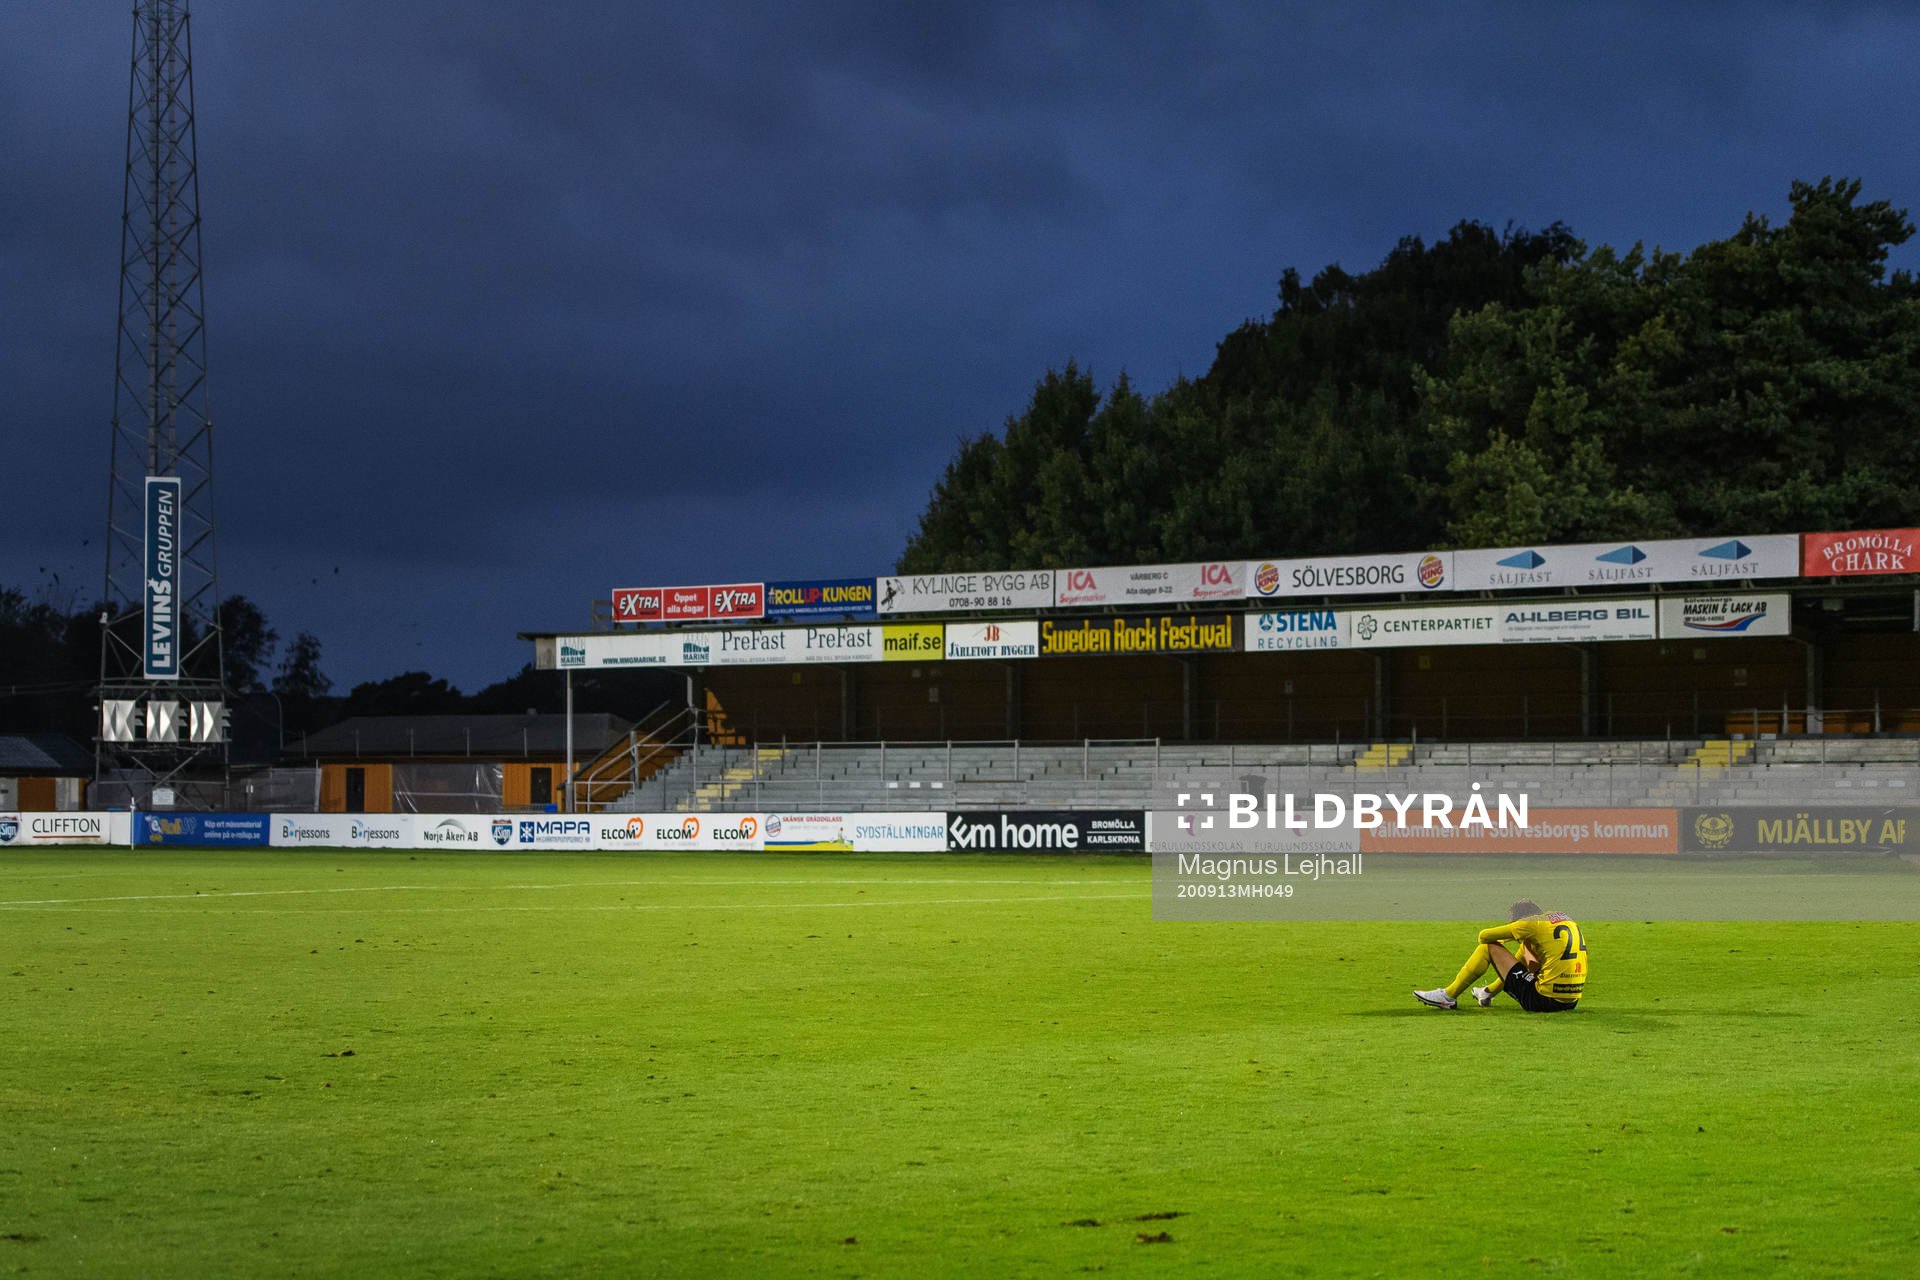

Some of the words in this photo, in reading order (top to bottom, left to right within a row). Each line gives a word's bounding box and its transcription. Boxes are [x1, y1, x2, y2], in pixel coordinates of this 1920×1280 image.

[157, 489, 173, 577] GRUPPEN
[1823, 533, 1913, 560] BROMÖLLA
[1831, 553, 1905, 572] CHARK
[1067, 570, 1097, 591] ICA
[1201, 564, 1233, 585] ICA
[1258, 573, 1280, 588] KING
[1292, 565, 1405, 587] SÖLVESBORG
[1421, 567, 1444, 583] KING
[912, 575, 977, 595] KYLINGE
[984, 574, 1025, 593] BYGG
[1029, 573, 1050, 590] AB
[674, 592, 698, 603] Öppet
[949, 598, 985, 608] 0708-90
[987, 597, 998, 606] 88
[1002, 596, 1012, 606] 16
[667, 604, 682, 613] alla
[683, 603, 705, 615] dagar
[1505, 609, 1609, 623] AHLBERG
[1616, 608, 1650, 620] BIL
[1683, 603, 1719, 615] MASKIN
[1731, 601, 1754, 613] LACK
[1754, 601, 1767, 613] AB
[151, 579, 172, 668] LEVINS
[1276, 609, 1337, 633] STENA
[1383, 617, 1494, 633] CENTERPARTIET
[805, 626, 873, 649] PreFast
[984, 624, 999, 641] JB
[1042, 619, 1111, 654] Sweden
[1114, 616, 1157, 652] Rock
[1160, 614, 1232, 650] Festival
[721, 630, 786, 651] PreFast
[884, 633, 941, 651] maif.se
[1257, 635, 1338, 649] RECYCLING
[683, 653, 710, 661] MARINE
[1001, 644, 1035, 656] BYGGER
[561, 656, 585, 665] MARINE
[32, 818, 101, 833] CLIFFTON
[537, 821, 590, 834] MAPA
[1001, 814, 1079, 848] home
[1091, 819, 1136, 829] BROMÖLLA
[1464, 820, 1485, 838] till
[1594, 820, 1668, 838] kommun
[1757, 813, 1872, 844] MJÄLLBY
[423, 831, 444, 842] Norje
[445, 829, 465, 841] Åkeri
[467, 832, 479, 841] AB
[601, 828, 636, 839] ELCOM
[656, 828, 692, 840] ELCOM
[713, 828, 749, 840] ELCOM
[856, 825, 944, 839] SYDSTÄLLNINGAR
[1086, 835, 1140, 844] KARLSKRONA
[1150, 841, 1244, 851] FURULUNDSSKOLAN
[1254, 840, 1353, 851] FURULUNDSSKOLAN
